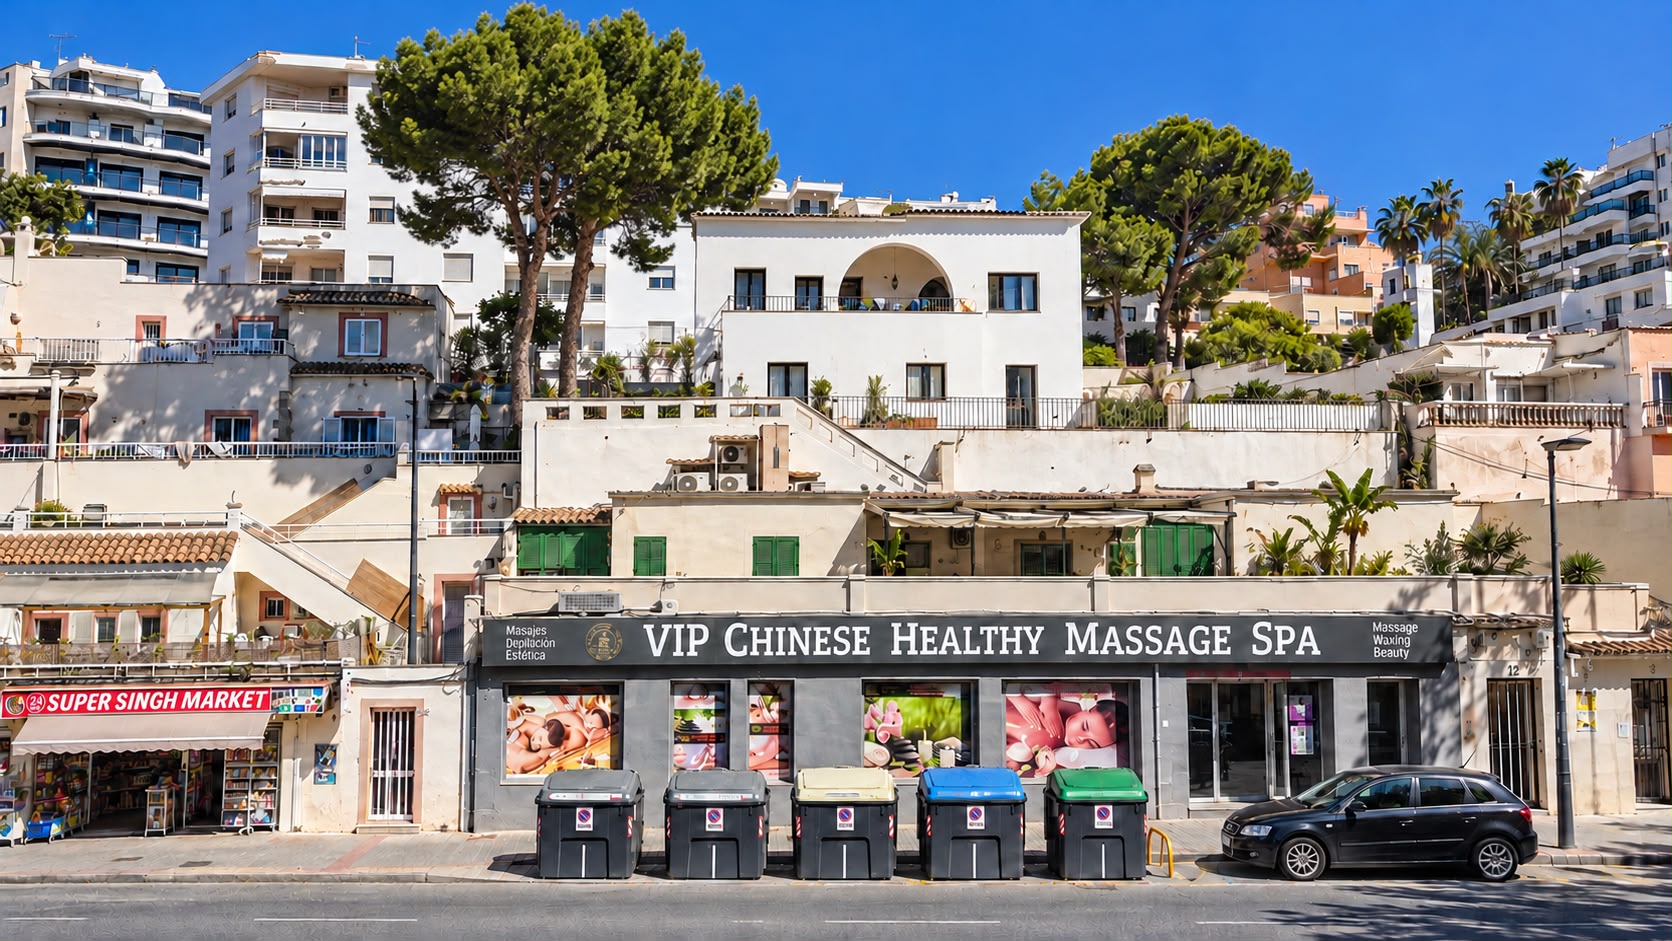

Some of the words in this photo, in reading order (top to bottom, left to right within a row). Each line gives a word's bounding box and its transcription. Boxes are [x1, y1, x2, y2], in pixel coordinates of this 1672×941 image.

[506, 625, 547, 638] Masajes
[1372, 621, 1419, 637] Massage
[643, 623, 709, 657] VIP
[724, 622, 871, 657] CHINESE
[890, 622, 1044, 656] HEALTHY
[1065, 621, 1231, 656] MASSAGE
[1252, 621, 1321, 656] SPA
[1373, 634, 1411, 648] Waxing
[506, 649, 546, 661] Estética
[1374, 646, 1410, 660] Beauty
[1508, 665, 1520, 676] 12
[47, 692, 112, 712] SUPER
[115, 691, 178, 711] SINGH
[180, 690, 268, 710] MARKET
